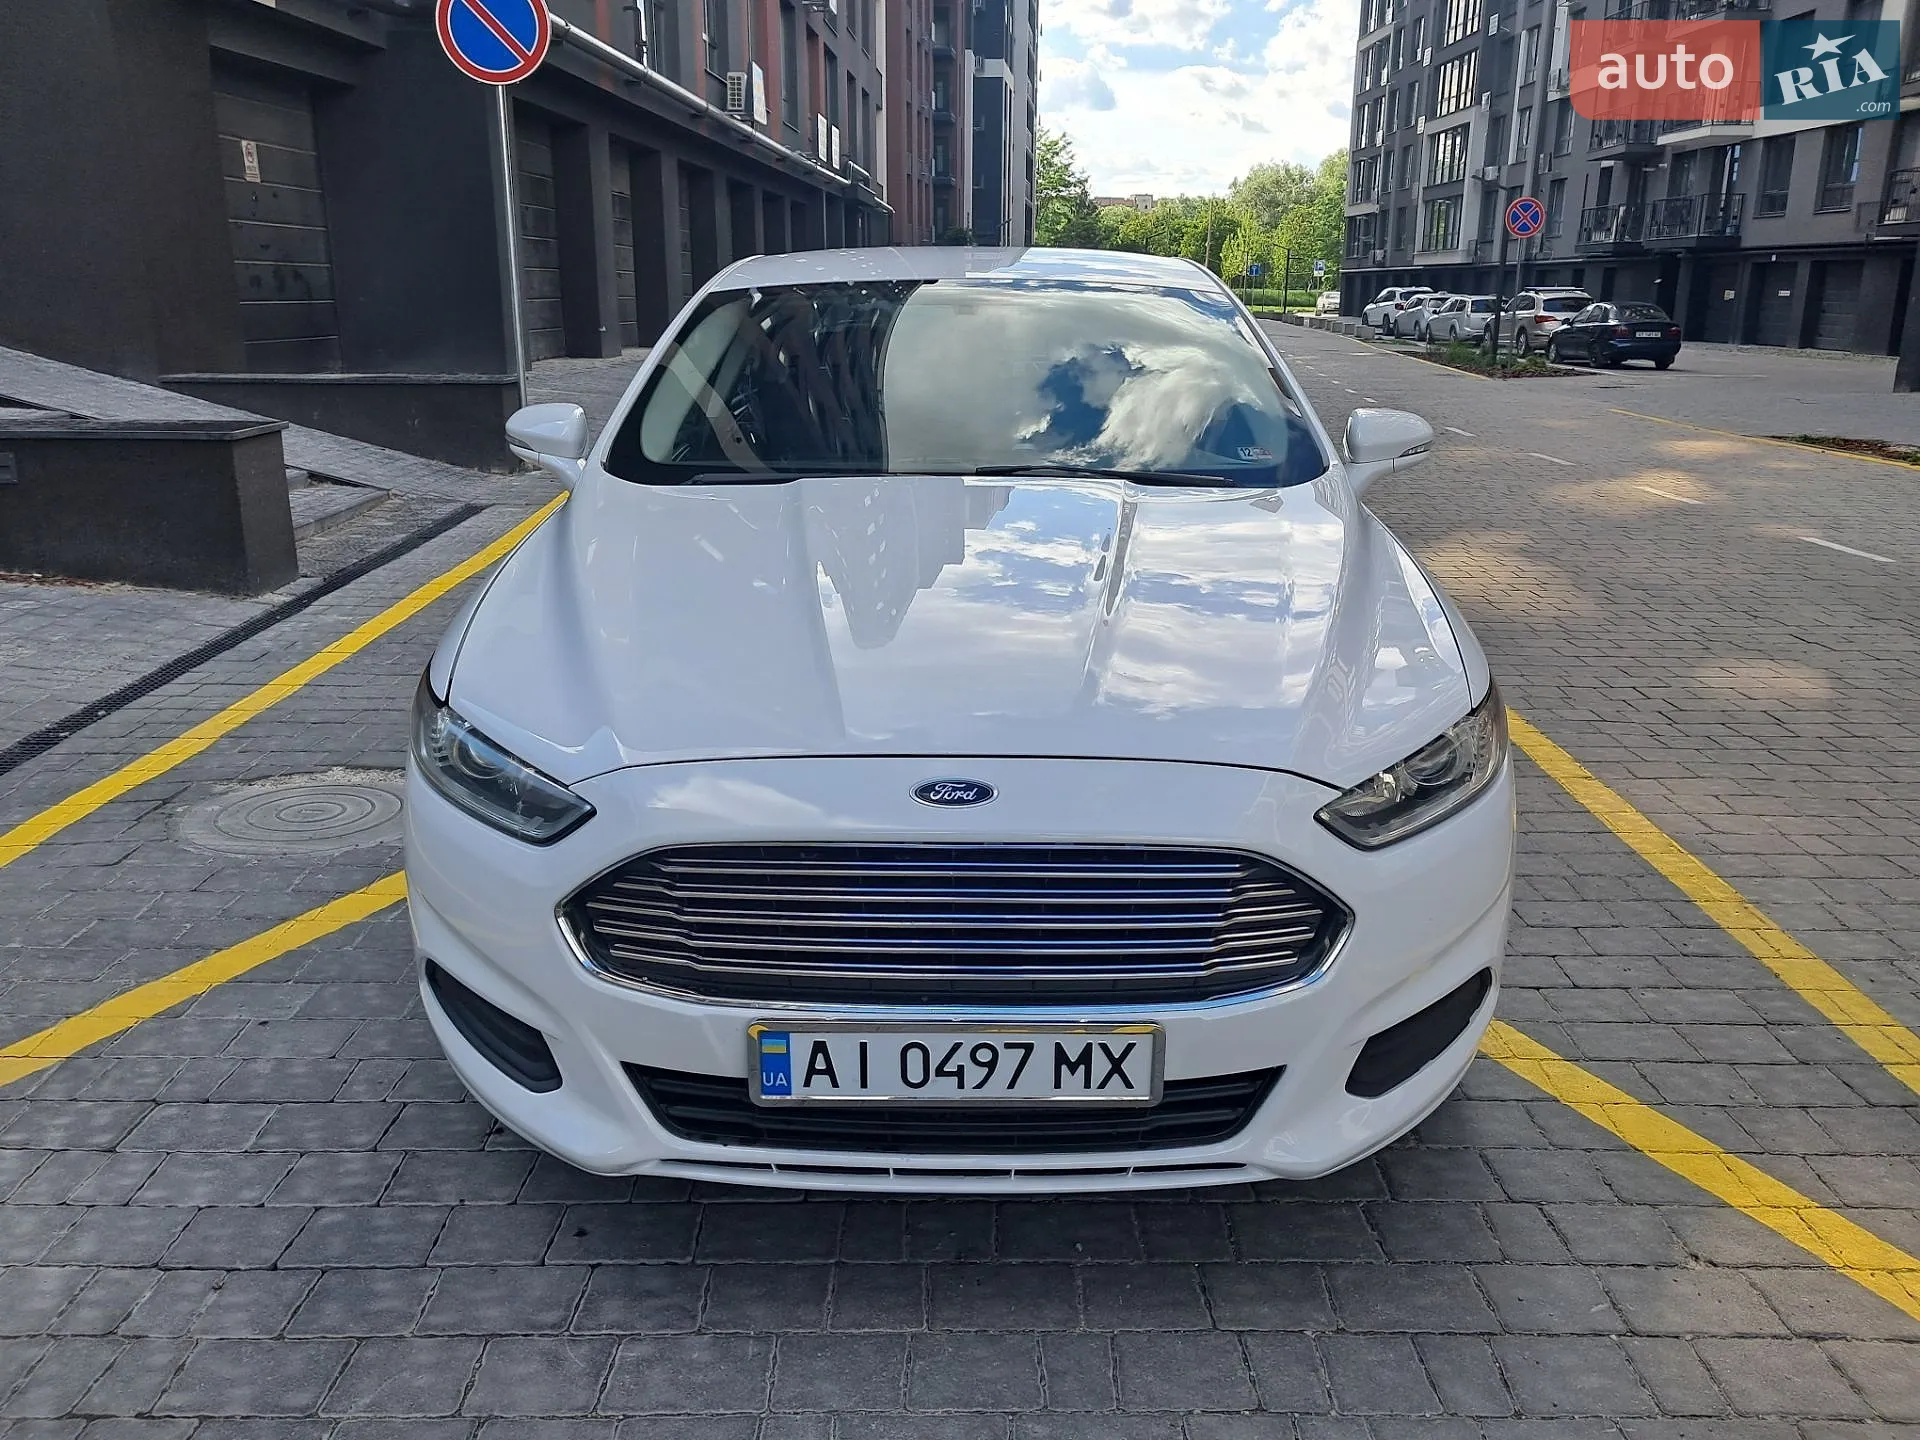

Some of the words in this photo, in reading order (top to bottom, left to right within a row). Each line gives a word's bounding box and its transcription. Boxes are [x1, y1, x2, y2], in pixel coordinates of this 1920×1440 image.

[930, 783, 978, 800] Ford
[802, 1040, 868, 1089] AI
[900, 1041, 1034, 1090] 0497
[1053, 1041, 1137, 1089] MX
[762, 1071, 788, 1087] UA
